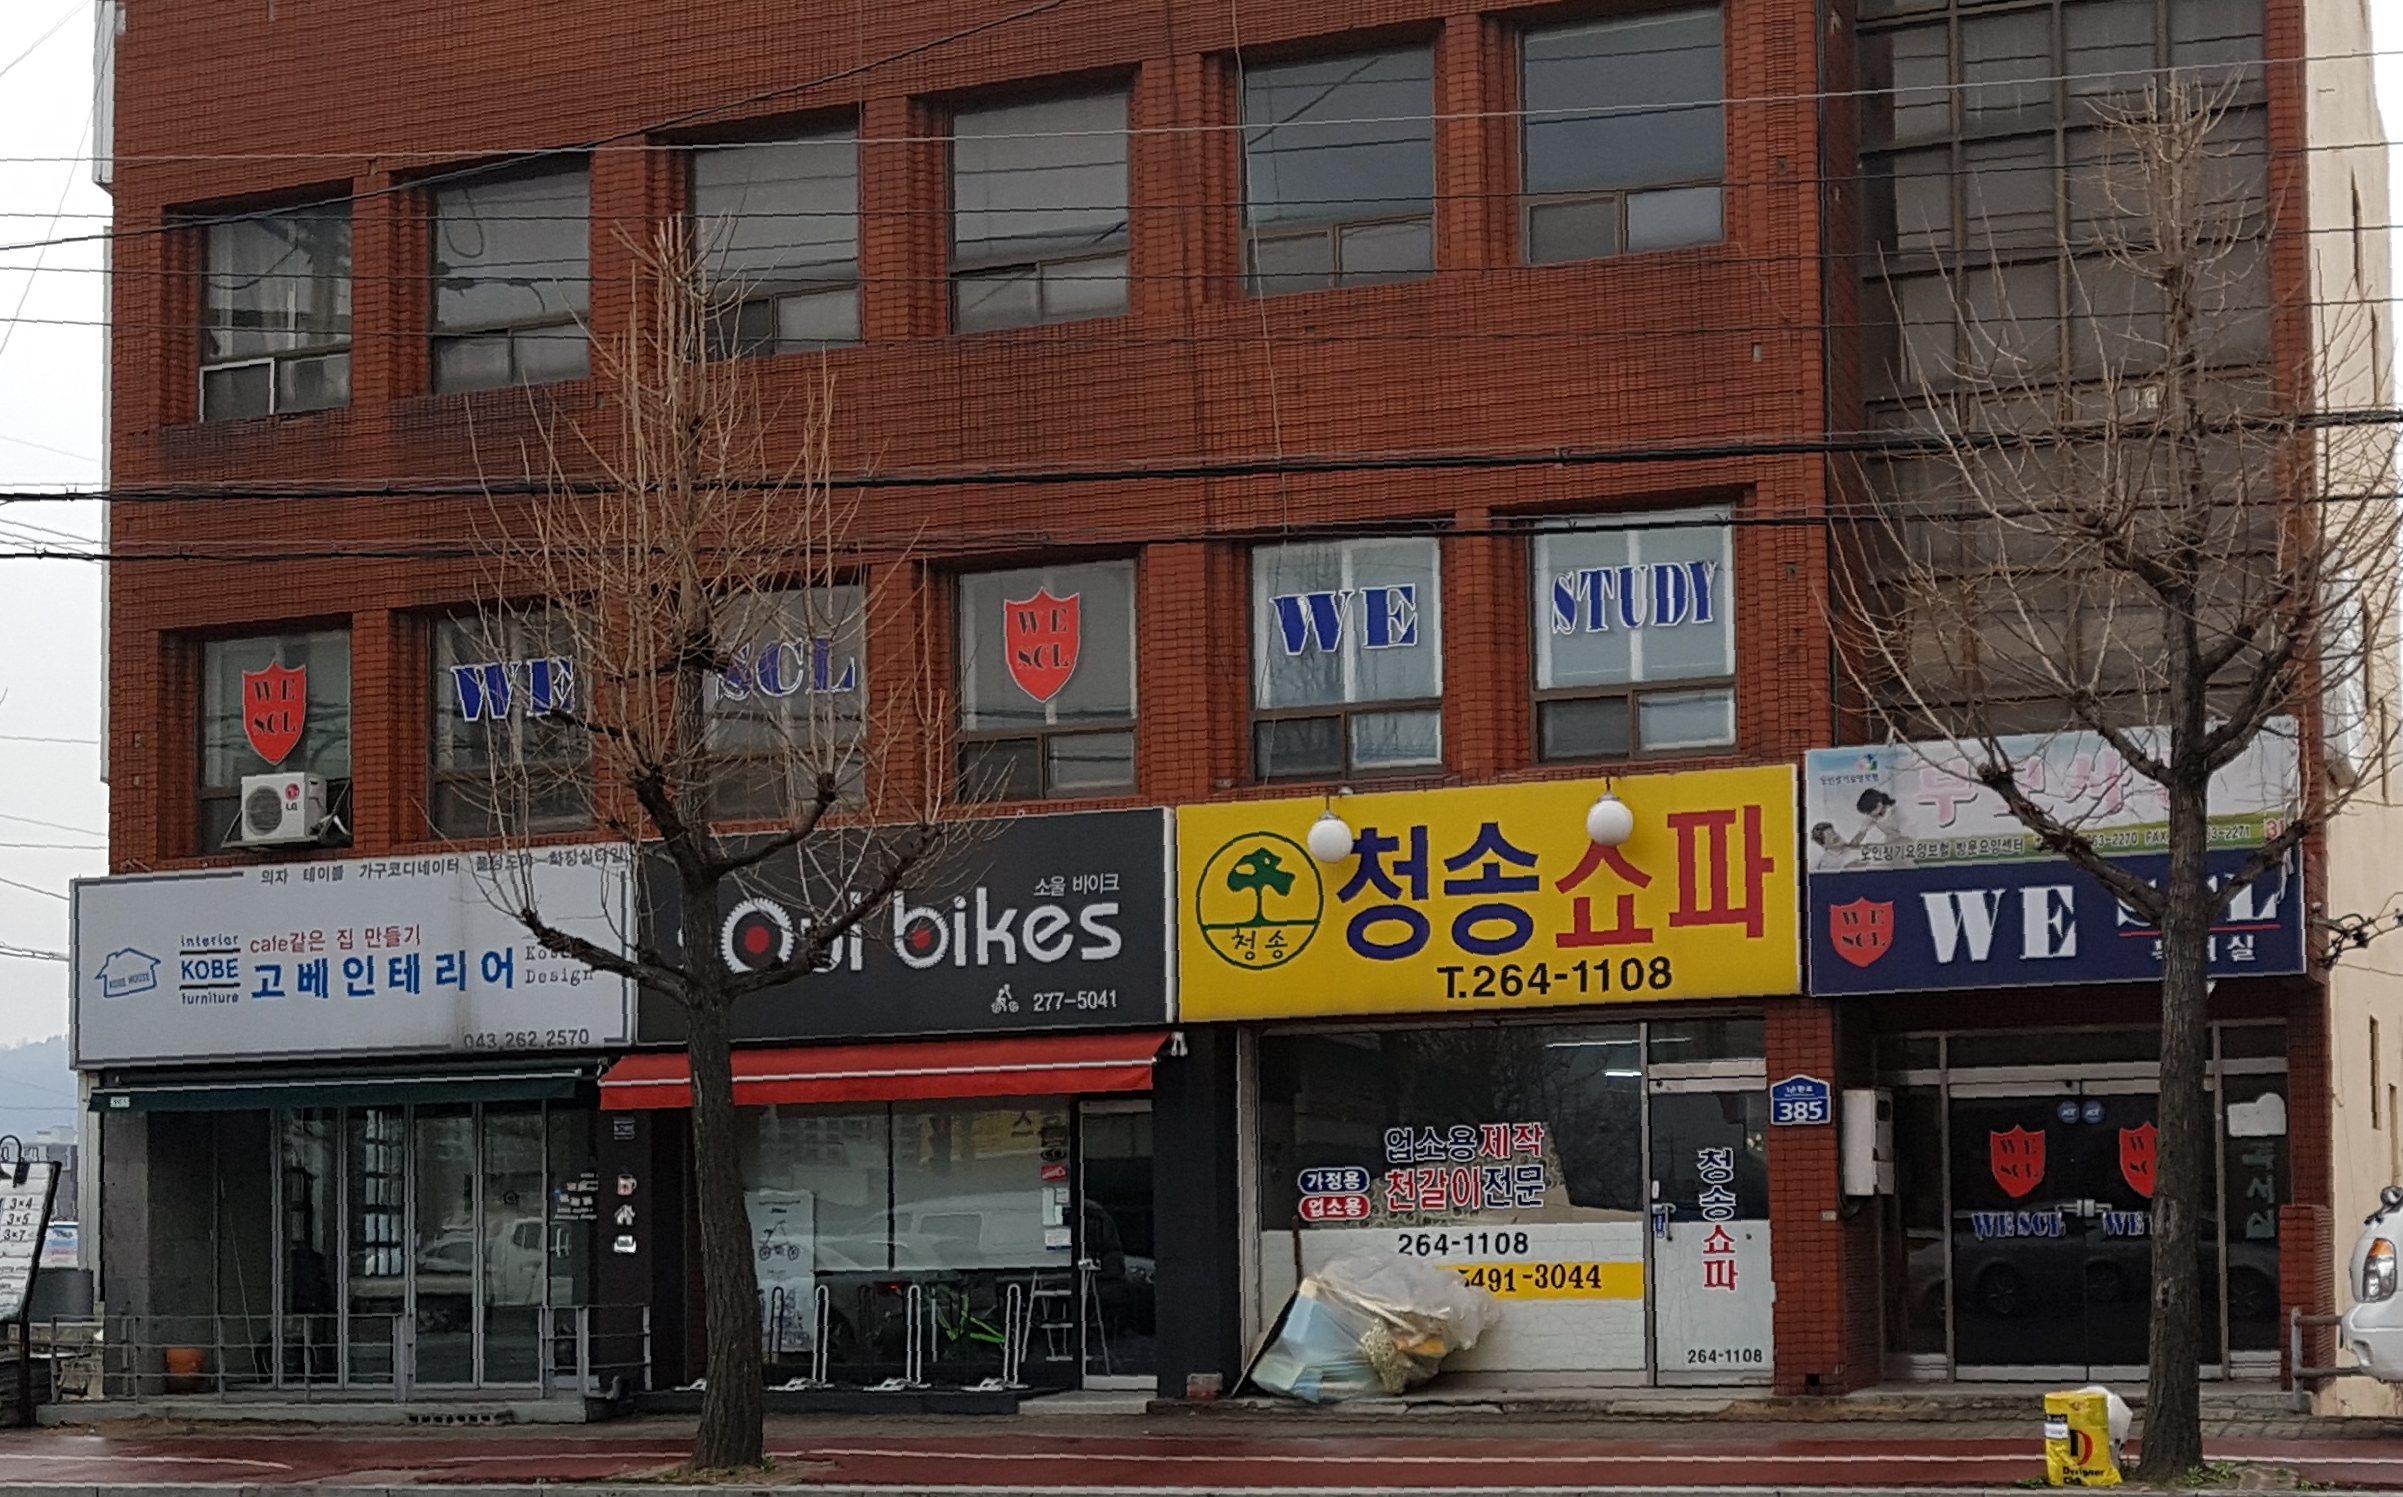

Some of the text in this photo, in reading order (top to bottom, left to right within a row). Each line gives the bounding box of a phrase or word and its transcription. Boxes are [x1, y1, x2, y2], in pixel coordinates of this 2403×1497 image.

[1550, 560, 1718, 636] STUDY
[1017, 608, 1068, 635] WE
[1270, 583, 1420, 658] WE
[1017, 644, 1071, 670] SCL
[253, 678, 297, 703] WE
[450, 637, 856, 722] WE SCL
[252, 711, 297, 736] SCL
[285, 801, 299, 812] LG
[1955, 838, 2024, 857] 방문요양센터
[260, 867, 289, 886] 의자
[303, 863, 344, 883] 테이블
[359, 857, 461, 881] 가구코디네이터
[1337, 803, 1776, 961] 청송쇼파
[1033, 872, 1120, 897] 소울 바이크
[892, 885, 1122, 969] bikes
[1841, 909, 1885, 926] WE
[1919, 884, 2078, 964] WE
[180, 933, 239, 947] interior
[250, 924, 421, 953] cafe같은 집 만들기
[1231, 928, 1289, 961] 청송
[1840, 932, 1886, 949] SCL
[181, 957, 239, 981] KOBE
[251, 945, 514, 999] 고베인테리어
[525, 967, 594, 986] Design
[1437, 955, 1673, 999] T.264-1108
[181, 991, 239, 1006] furniture
[1033, 989, 1117, 1012] 277-5041
[463, 1029, 590, 1050] 043.262.2570
[1778, 1100, 1823, 1121] 385
[1384, 1122, 1546, 1164] 업소용제작
[1306, 1170, 1362, 1191] 가정용
[1384, 1164, 1547, 1212] 천갈이전문
[1307, 1197, 1363, 1217] 업소용
[1697, 1148, 1740, 1292] 청송쇼파
[1397, 1231, 1530, 1257] 264-1108
[1687, 1348, 1763, 1364] 264-1108
